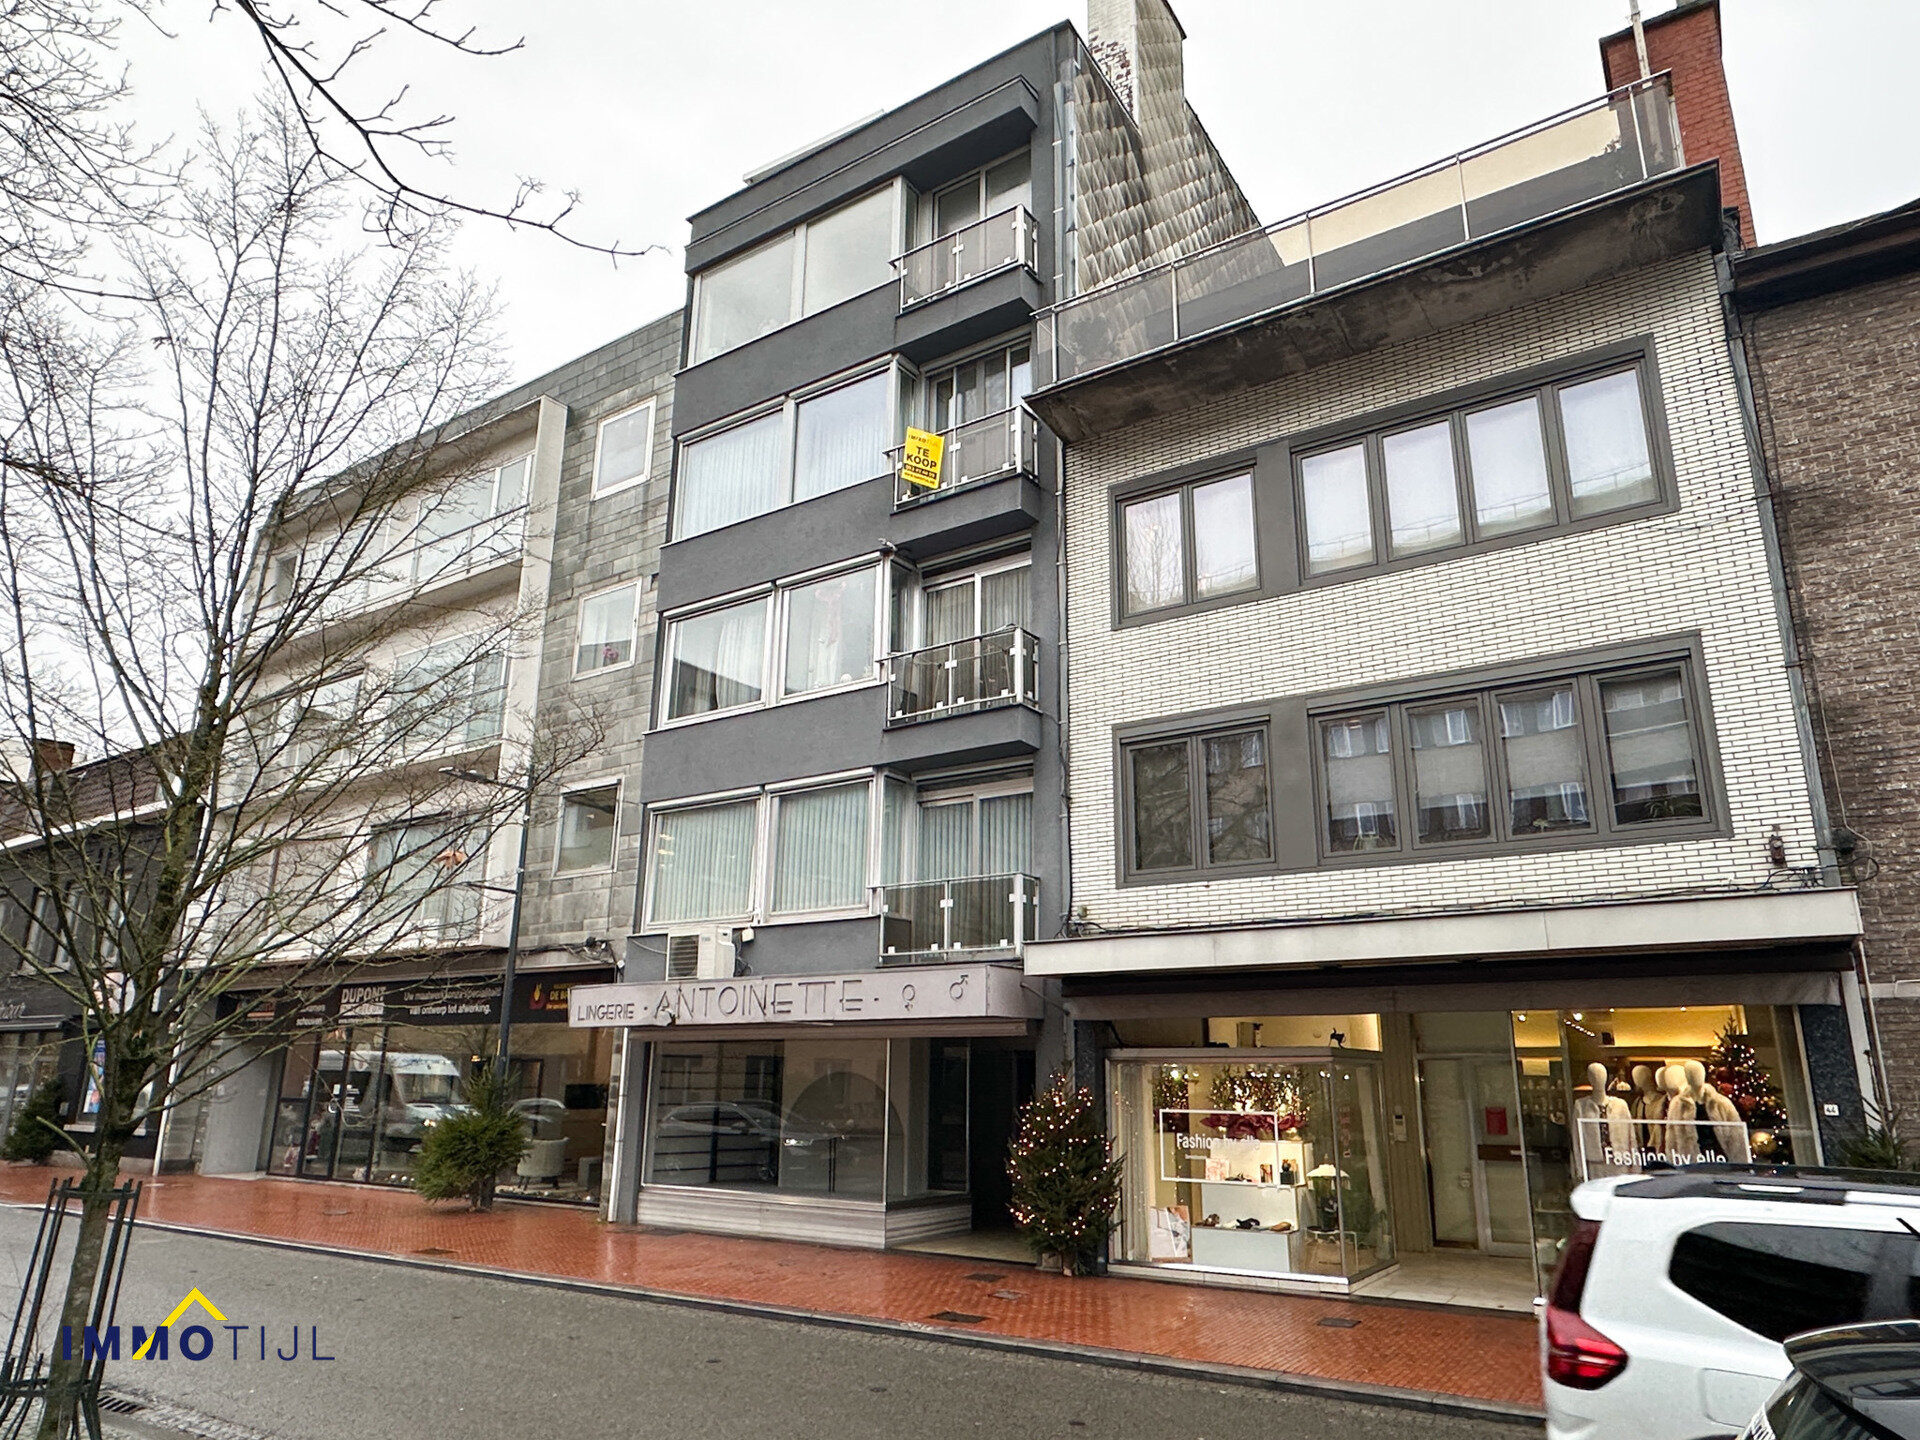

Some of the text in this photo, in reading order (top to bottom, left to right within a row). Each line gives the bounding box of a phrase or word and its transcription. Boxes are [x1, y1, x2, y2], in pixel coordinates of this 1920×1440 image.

[916, 446, 929, 457] TE
[906, 453, 937, 468] KOOP
[340, 986, 386, 1003] DUPONT
[577, 979, 862, 1020] LINGERIE ANTOINETTE
[1176, 1132, 1219, 1149] Fashion
[1604, 1146, 1666, 1167] Fashion
